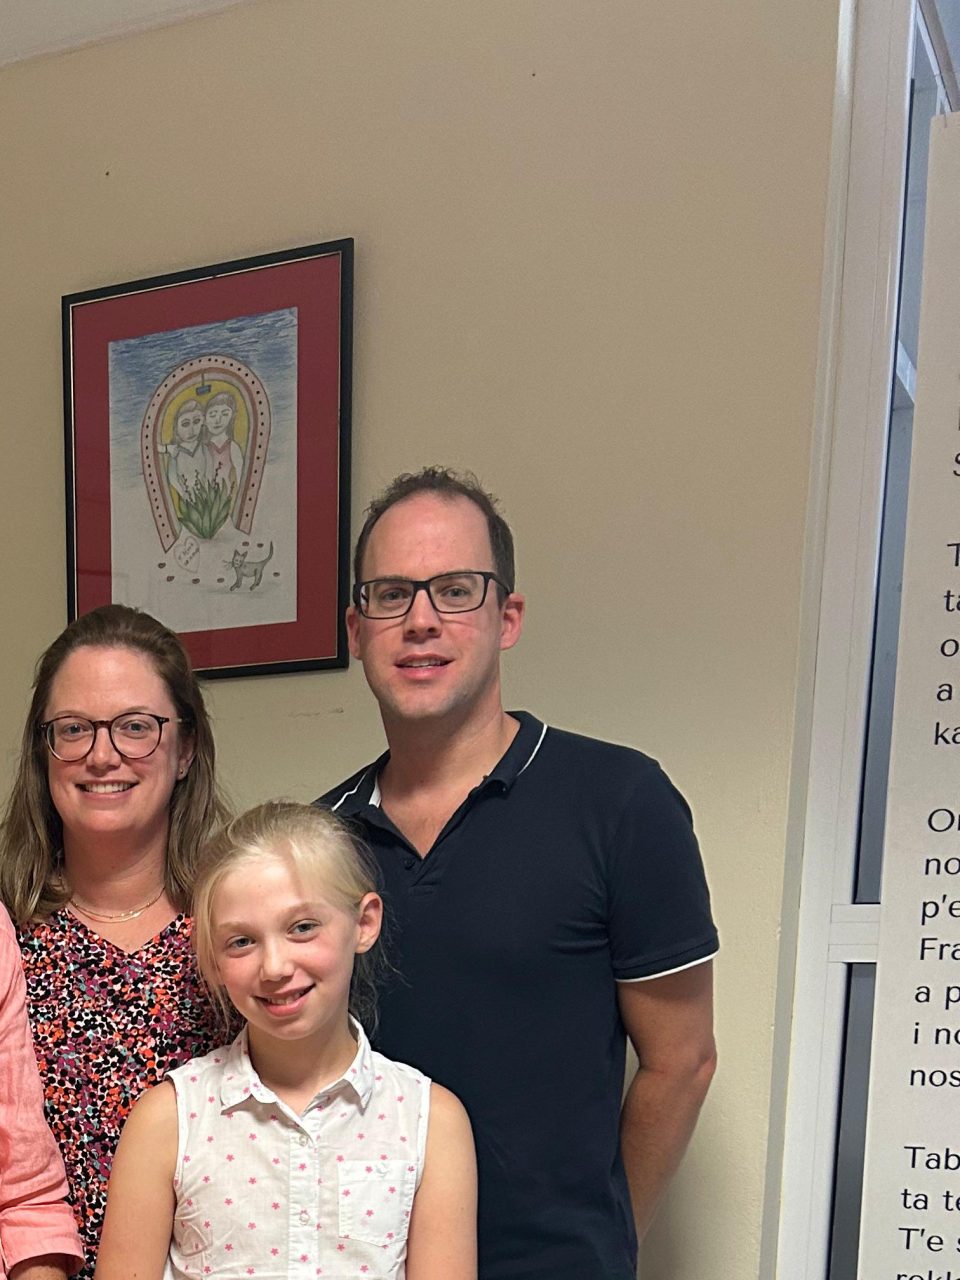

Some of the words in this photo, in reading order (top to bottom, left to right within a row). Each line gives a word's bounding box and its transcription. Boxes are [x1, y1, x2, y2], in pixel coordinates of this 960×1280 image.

[944, 590, 960, 612] t
[936, 683, 953, 702] a
[925, 857, 960, 876] no
[915, 986, 930, 1003] a
[913, 1022, 920, 1045] i
[910, 1069, 960, 1088] nos
[904, 1146, 960, 1171] Tab
[901, 1189, 928, 1210] ta
[898, 1228, 944, 1253] T'e
